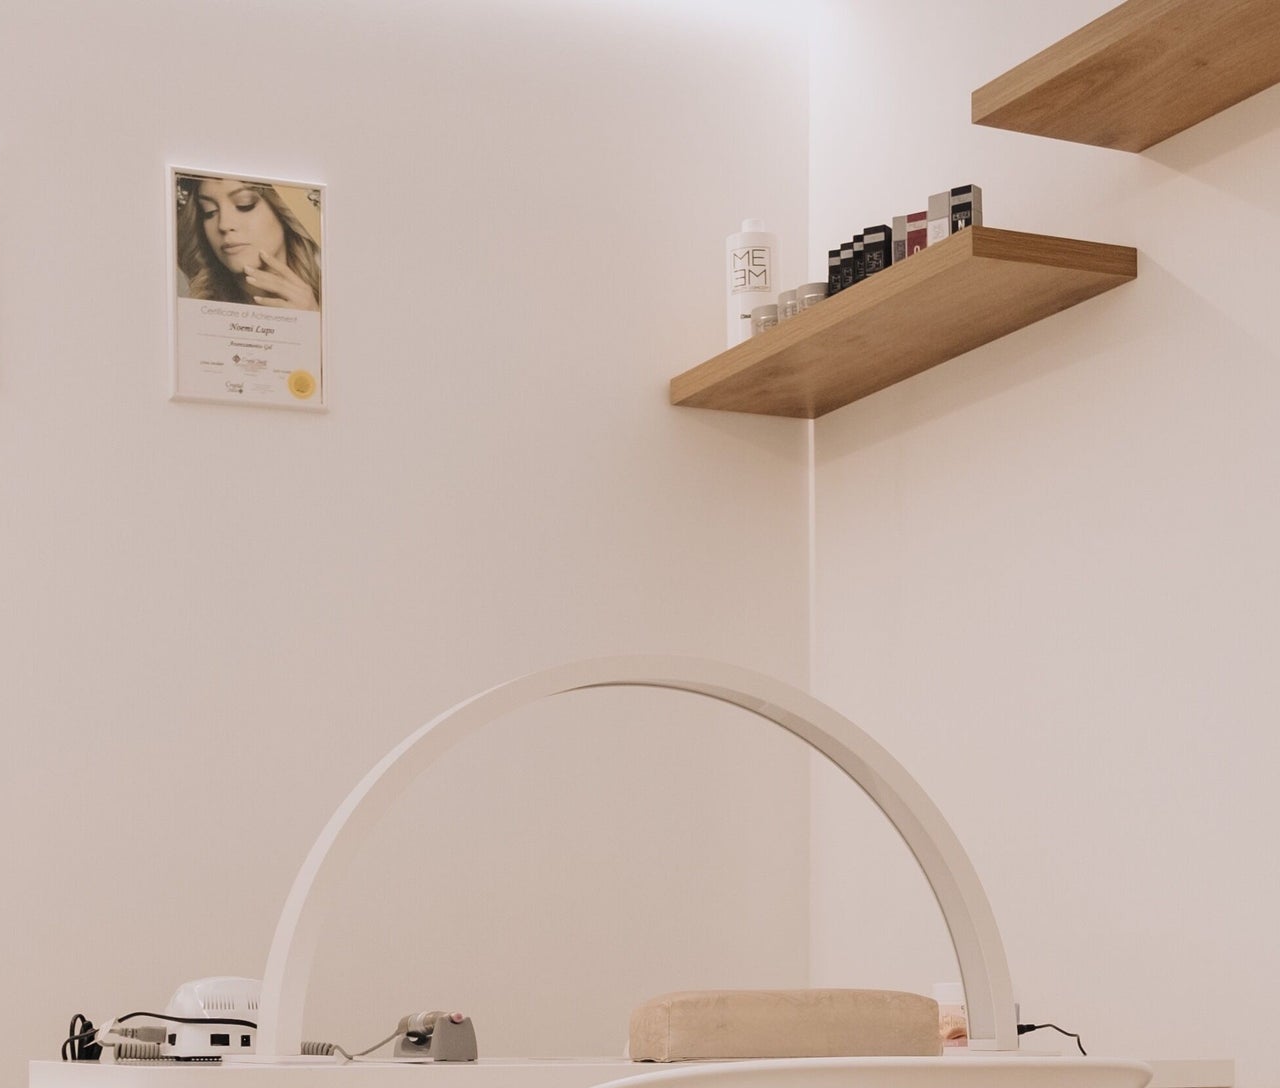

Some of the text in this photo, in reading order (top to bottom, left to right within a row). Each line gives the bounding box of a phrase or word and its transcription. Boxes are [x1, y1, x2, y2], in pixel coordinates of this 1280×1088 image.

[733, 248, 767, 268] ME
[200, 305, 239, 318] Certificate
[229, 323, 275, 337] Noemi Lupo
